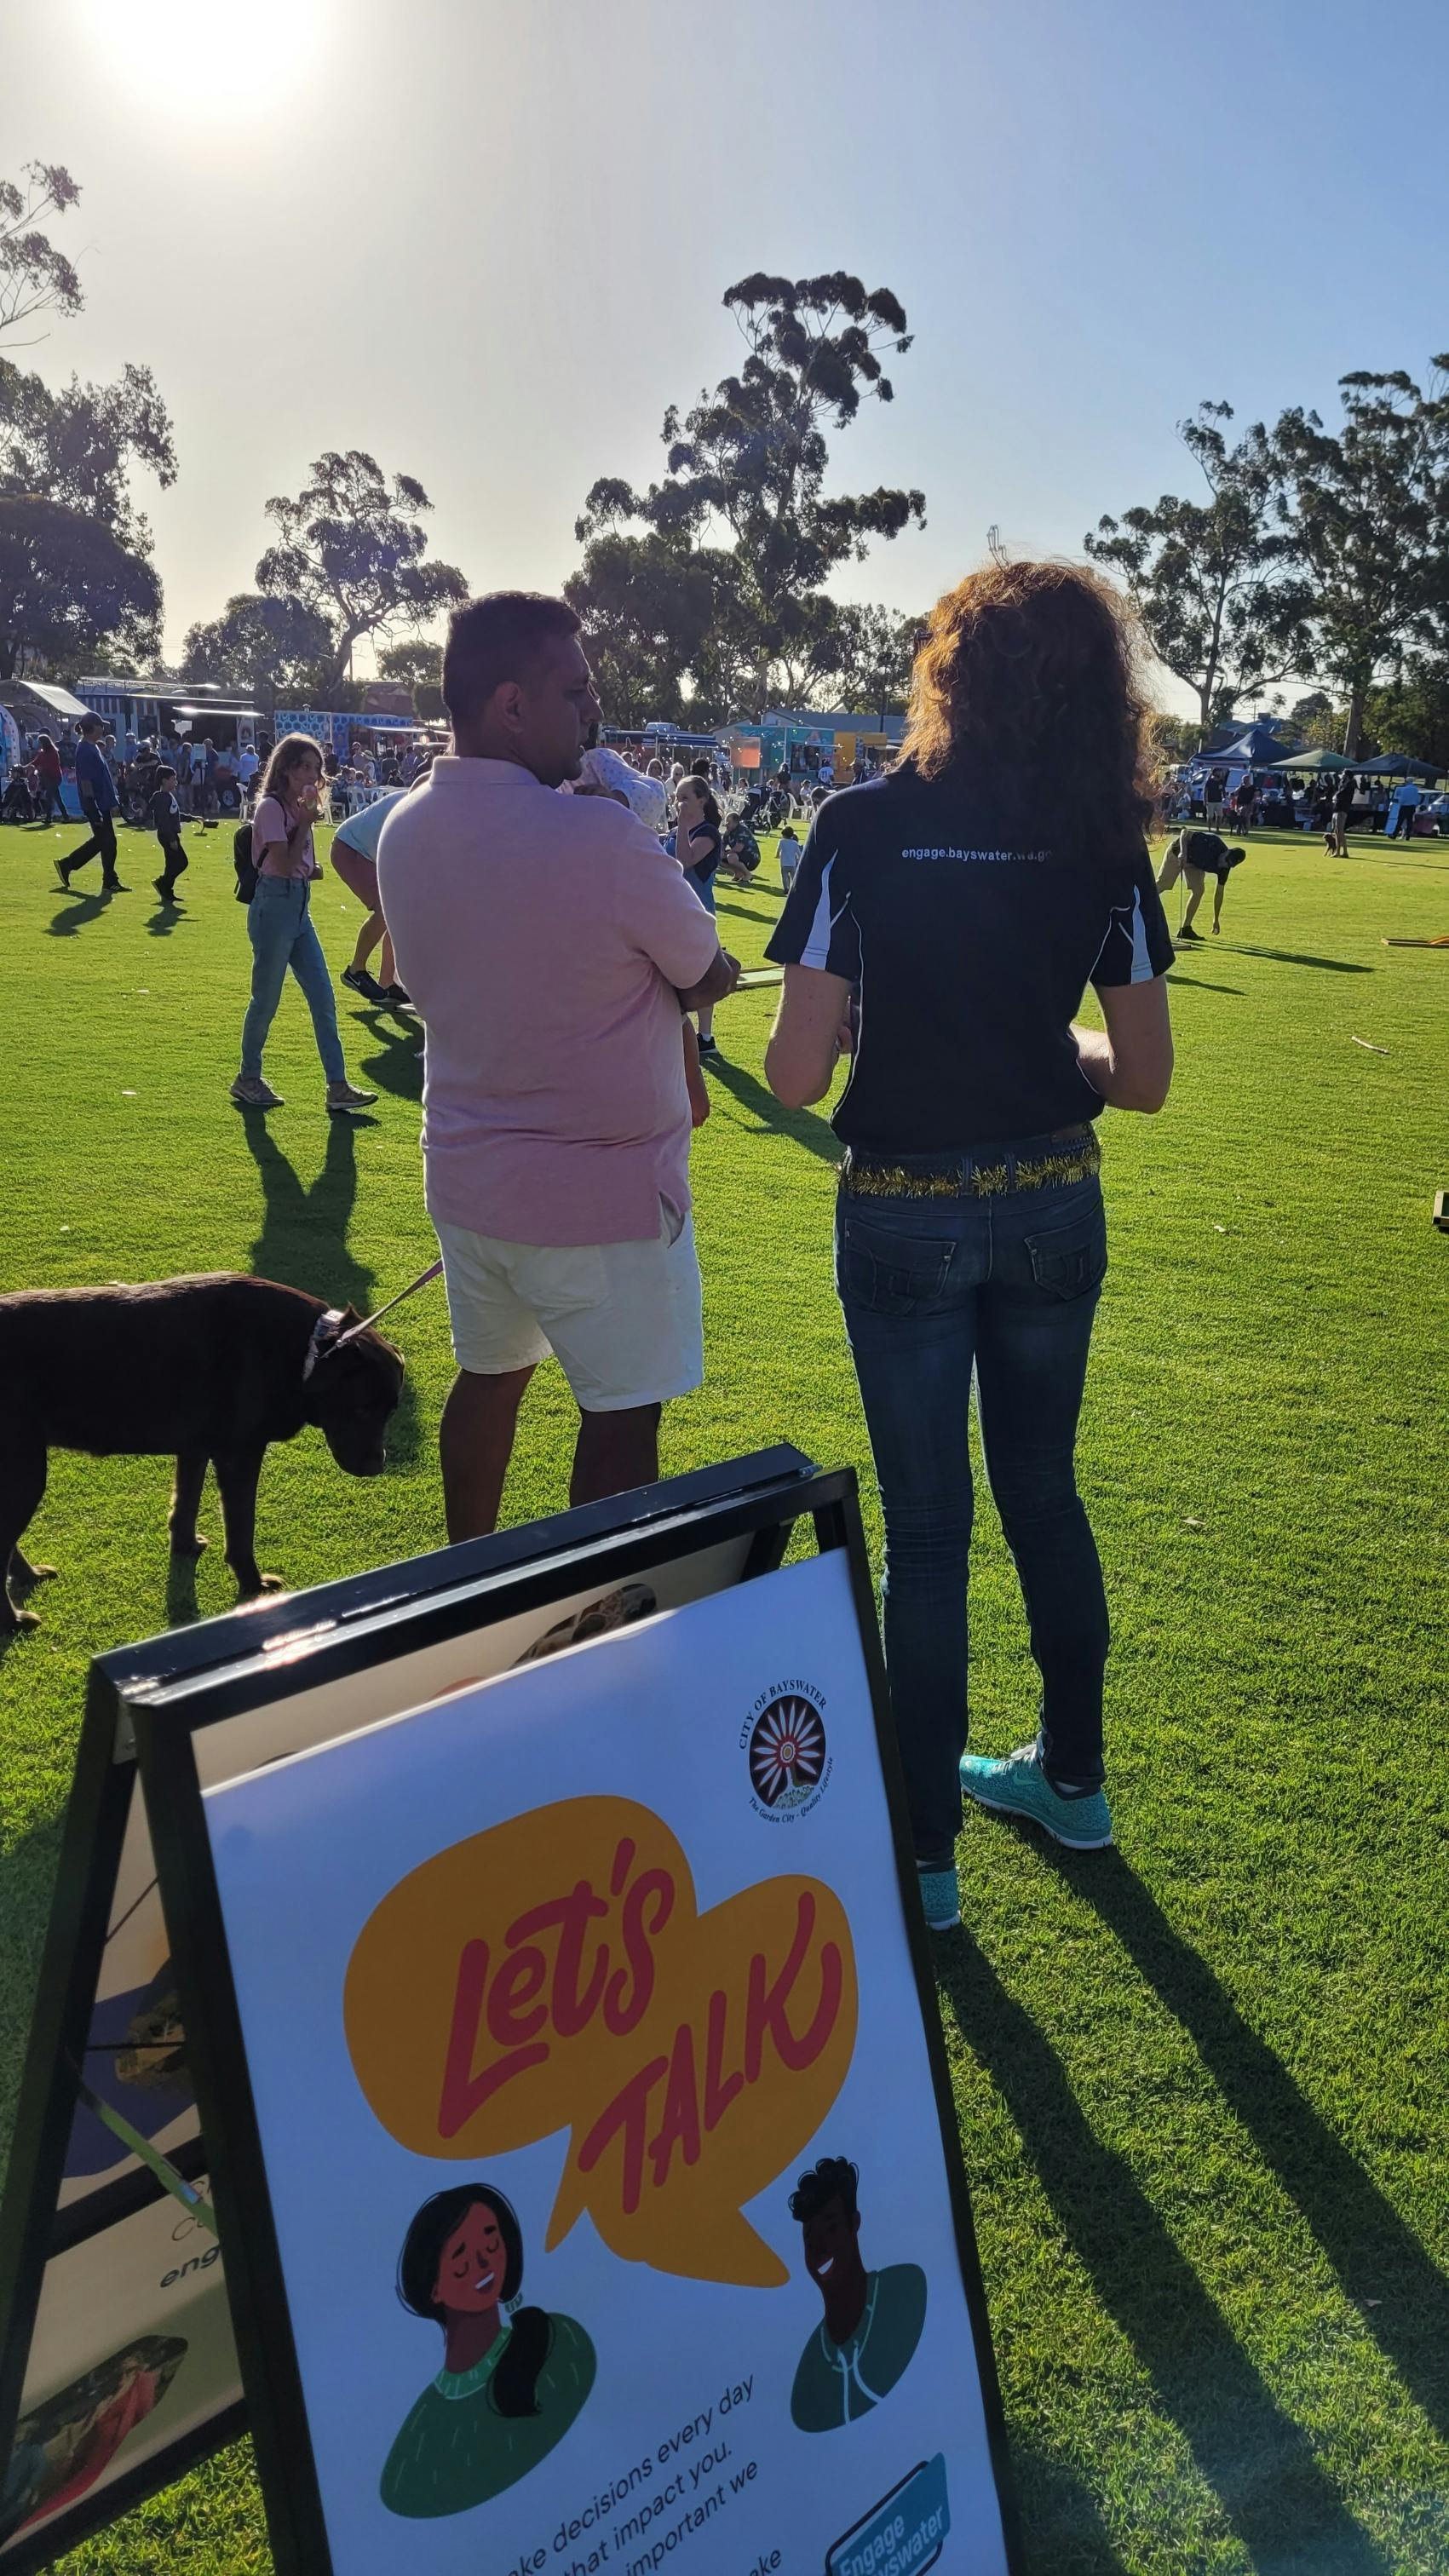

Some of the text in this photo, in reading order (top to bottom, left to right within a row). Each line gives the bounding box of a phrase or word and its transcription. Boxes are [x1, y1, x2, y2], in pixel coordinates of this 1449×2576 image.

[739, 1679, 827, 1749] CITY OF BAYSWATER
[749, 1797, 760, 1812] The
[759, 1808, 780, 1823] Garden
[781, 1813, 795, 1823] City
[801, 1793, 821, 1817] Quality
[820, 1757, 833, 1794] Lifestyle
[578, 1891, 842, 2215] TALK
[553, 2457, 653, 2553] decisions
[658, 2407, 713, 2464] every
[719, 2374, 754, 2415] day
[614, 2474, 686, 2551] impact
[688, 2441, 733, 2490] you.
[625, 2461, 758, 2576] important we
